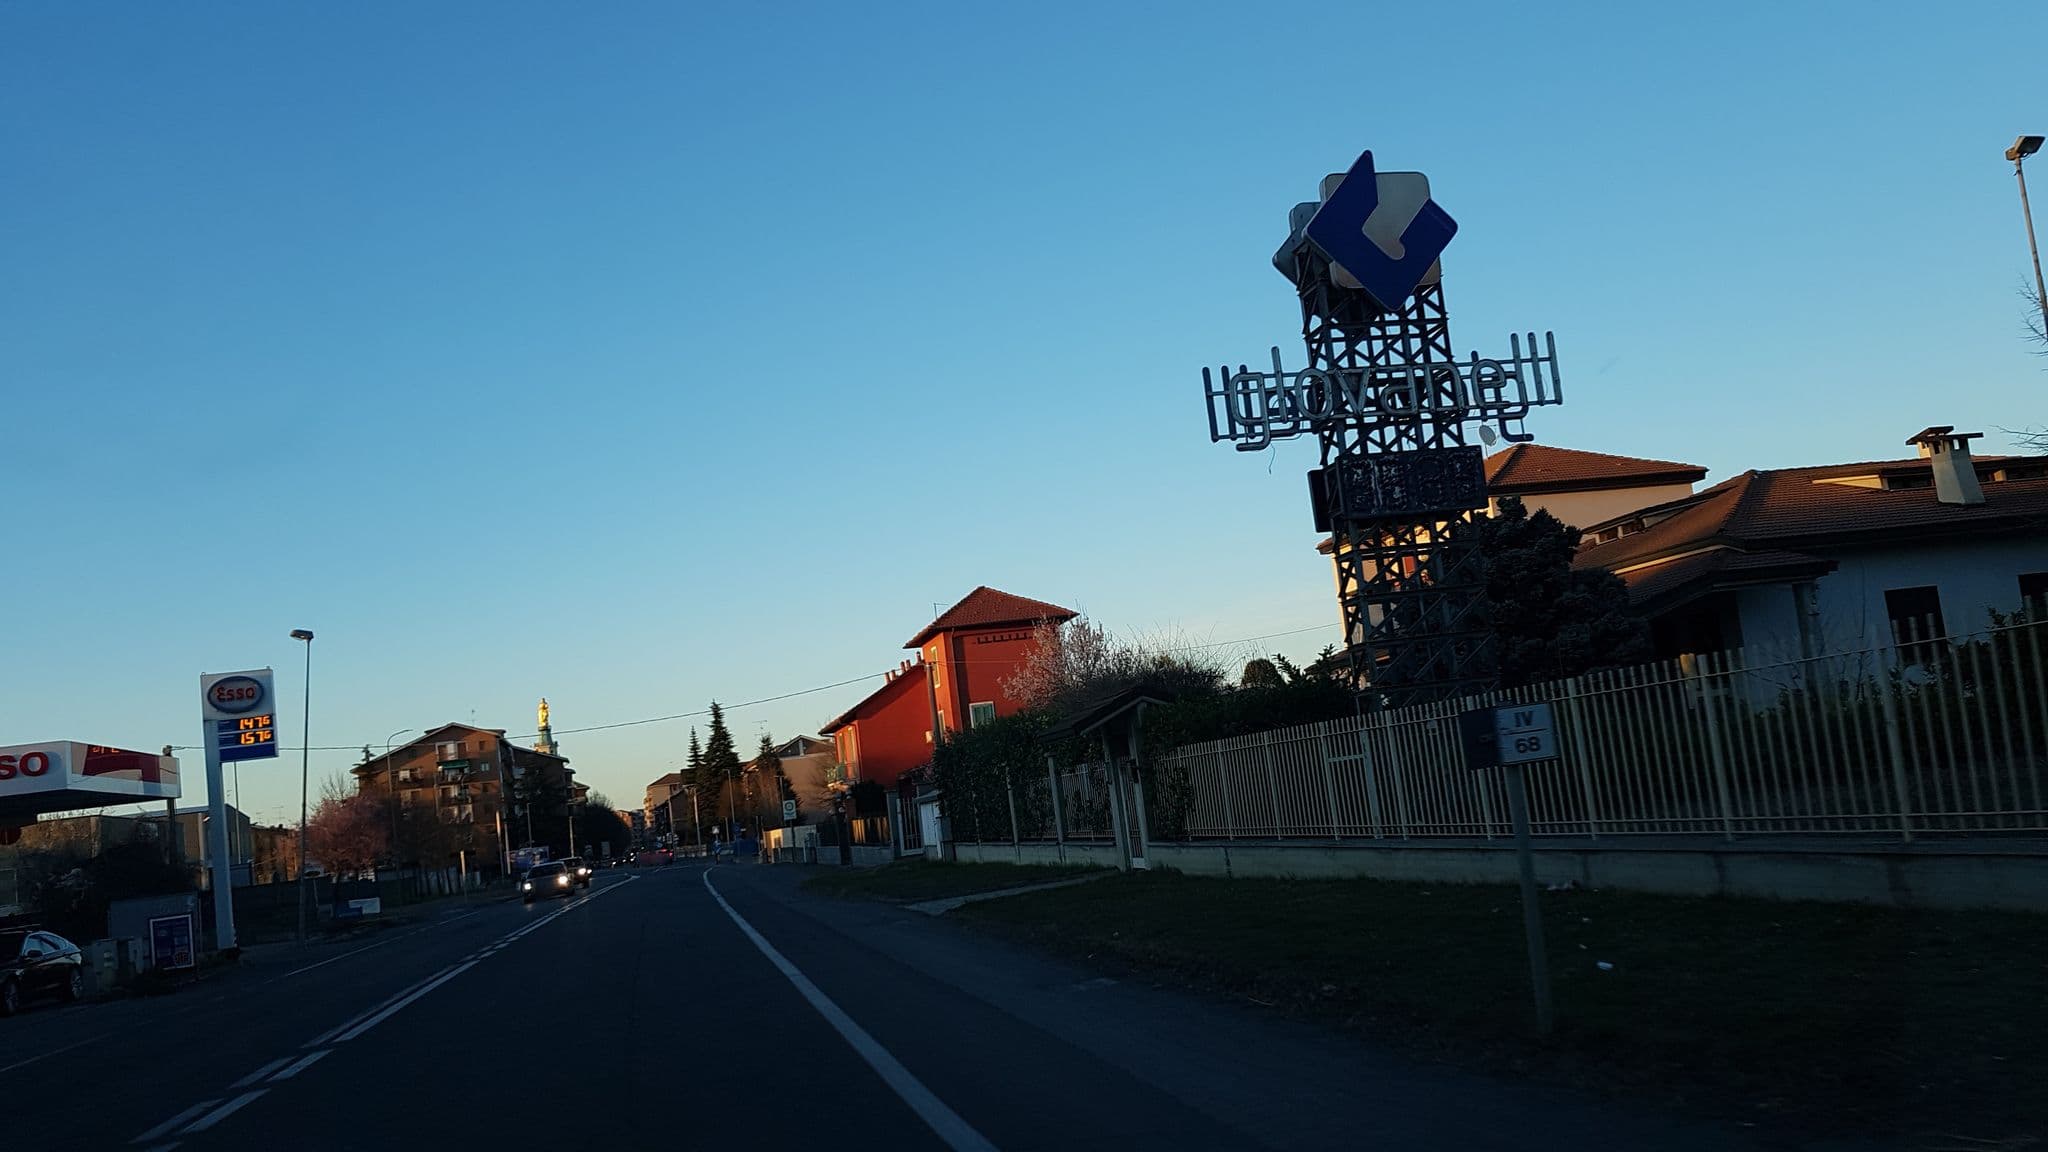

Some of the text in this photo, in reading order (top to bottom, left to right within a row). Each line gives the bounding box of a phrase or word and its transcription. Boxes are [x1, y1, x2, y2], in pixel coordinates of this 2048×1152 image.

[216, 686, 255, 702] Esso
[1514, 710, 1533, 728] IV
[1516, 736, 1541, 754] 68
